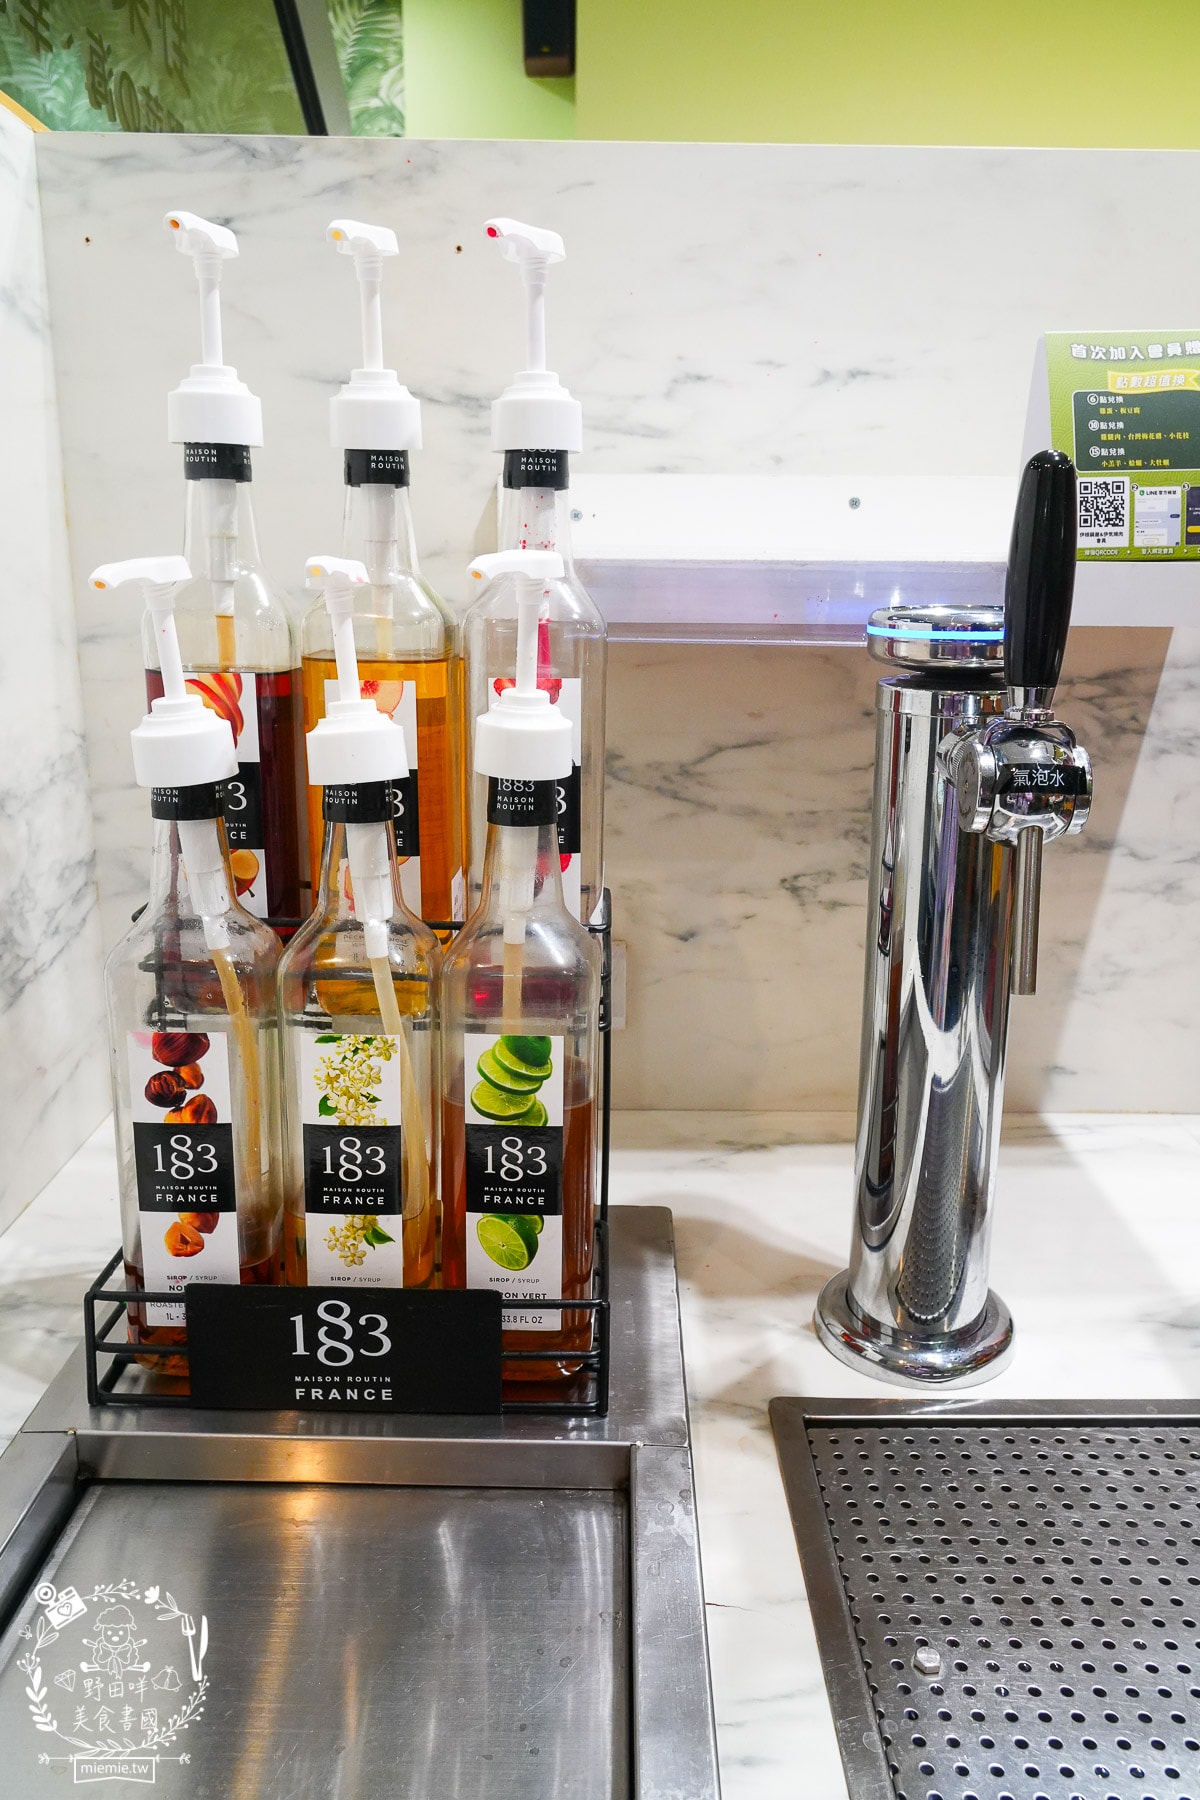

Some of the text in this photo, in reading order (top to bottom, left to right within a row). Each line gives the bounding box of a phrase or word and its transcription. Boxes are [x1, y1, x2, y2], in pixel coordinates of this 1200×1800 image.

[1115, 374, 1186, 389] 點數超值換
[370, 462, 405, 470] ROUTIN
[520, 464, 557, 472] ROUTIN
[1013, 769, 1065, 787] 氣泡水
[496, 803, 534, 811] ROUTIN
[153, 1134, 218, 1180] 1883
[322, 1136, 386, 1182] 1883
[484, 1136, 547, 1182] 1883
[156, 1193, 218, 1203] FRANCE
[323, 1195, 385, 1205] FRANCE
[484, 1195, 545, 1205] FRANCE
[290, 1300, 392, 1366] 1883
[295, 1388, 393, 1401] FRANCE
